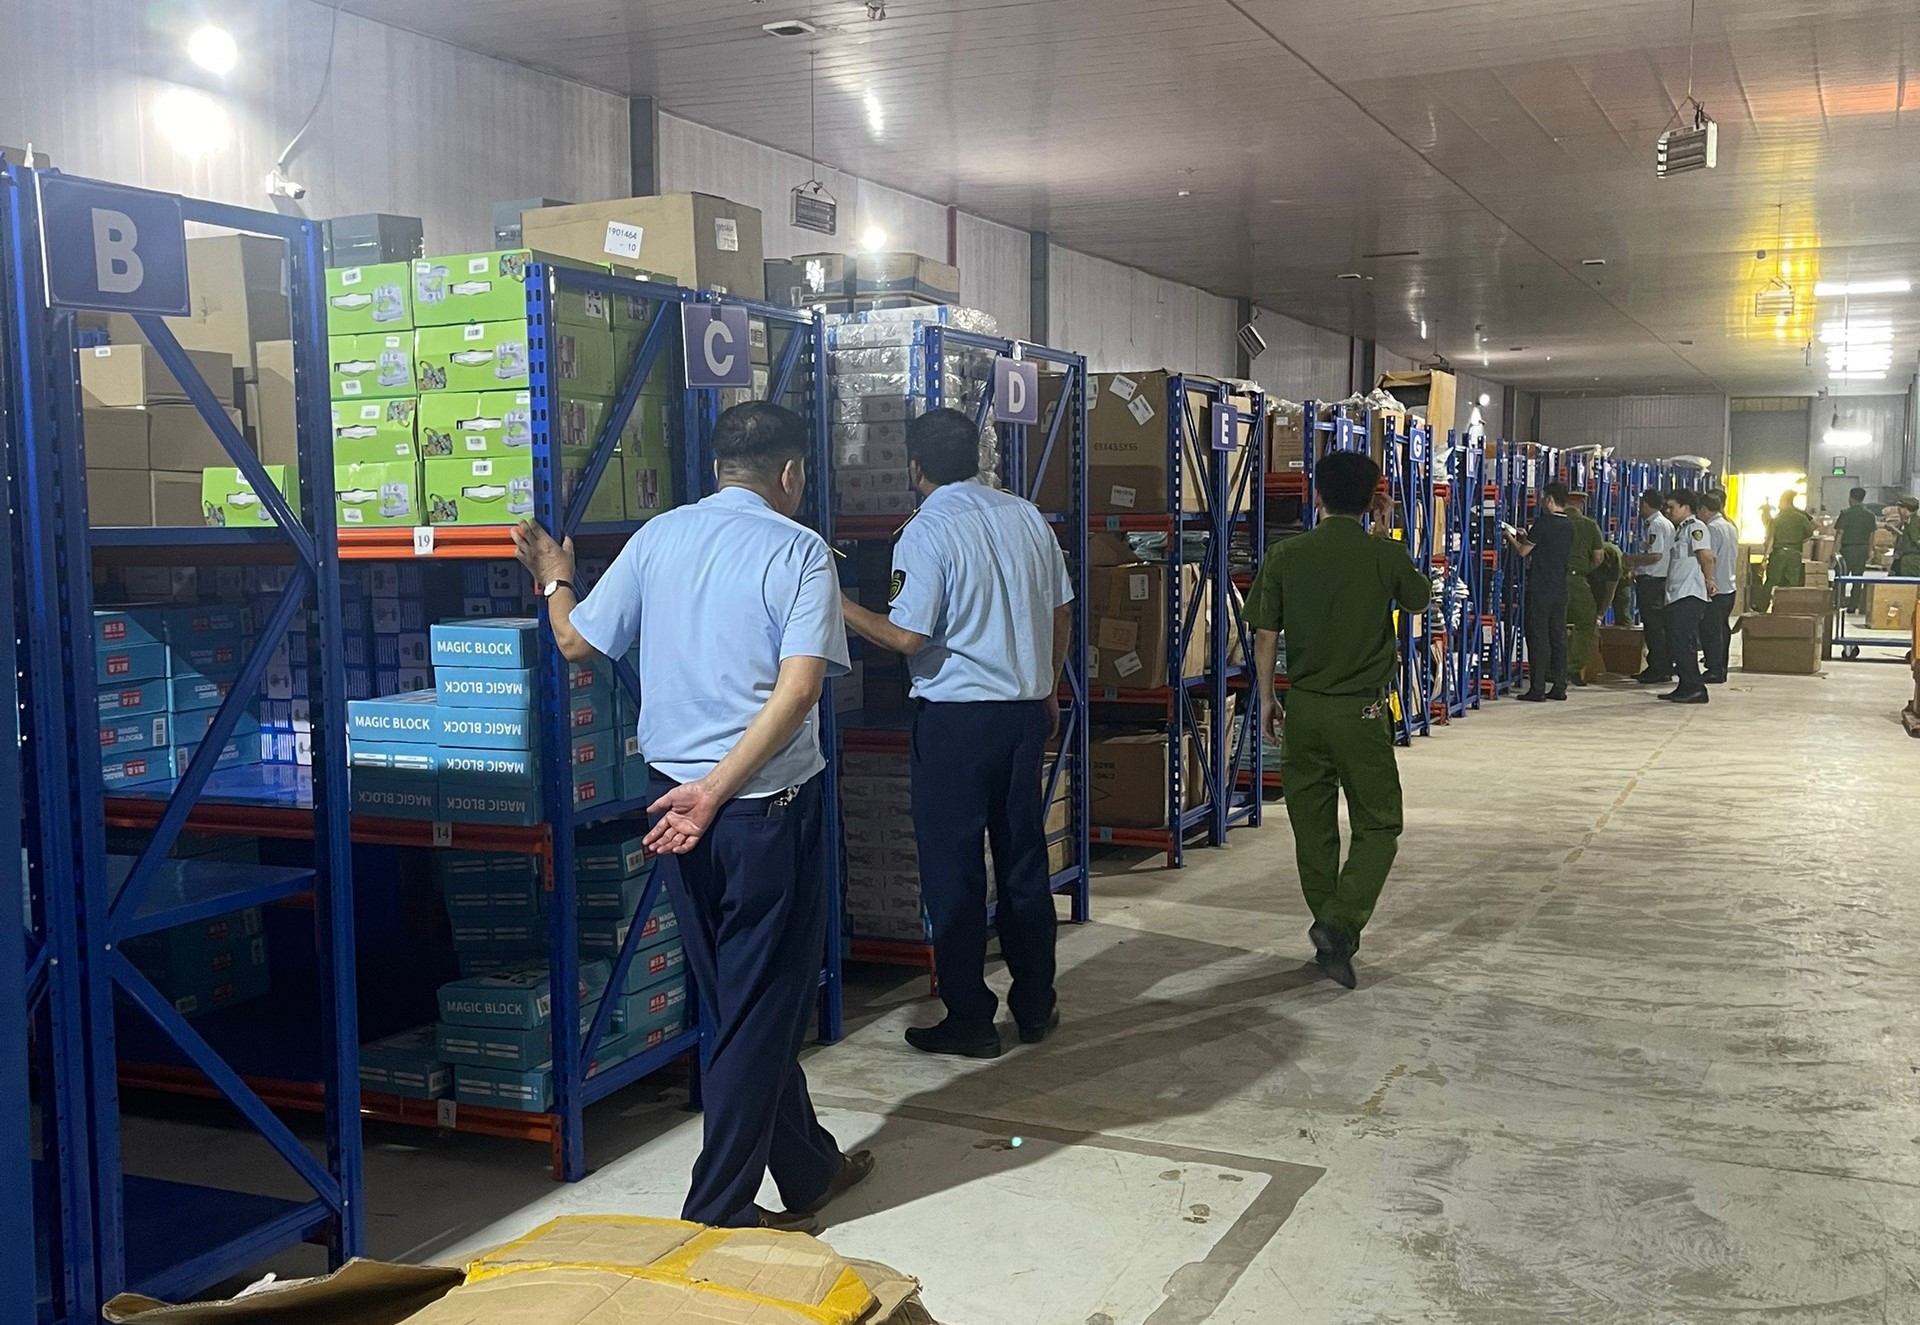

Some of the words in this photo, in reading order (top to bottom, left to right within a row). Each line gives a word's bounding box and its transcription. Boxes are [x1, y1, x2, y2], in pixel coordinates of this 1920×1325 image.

[608, 227, 637, 240] 1901464
[91, 207, 144, 294] B
[627, 243, 637, 252] 10
[704, 320, 734, 377] C
[1008, 370, 1026, 414] D
[1221, 413, 1230, 445] E
[1413, 434, 1424, 459] G
[417, 535, 430, 549] 19
[437, 641, 472, 654] MAGIC
[475, 642, 512, 655] BLOCK
[444, 681, 482, 694] BLOCK
[486, 682, 523, 695] MAGIC
[355, 716, 389, 728] MAGIC
[392, 717, 430, 730] BLOCK
[444, 721, 481, 734] BLOCK
[485, 723, 522, 735] MAGIC
[446, 758, 483, 771] BLOCK
[487, 760, 524, 774] MAGIC
[358, 791, 394, 804] BLOCK
[398, 793, 432, 806] MAGIC
[447, 797, 485, 811] BLOCK
[488, 799, 526, 813] MAGIC
[437, 827, 449, 838] 14
[447, 1001, 482, 1013] MAGIC
[485, 1003, 523, 1015] BLOCK
[444, 1108, 450, 1119] 3
